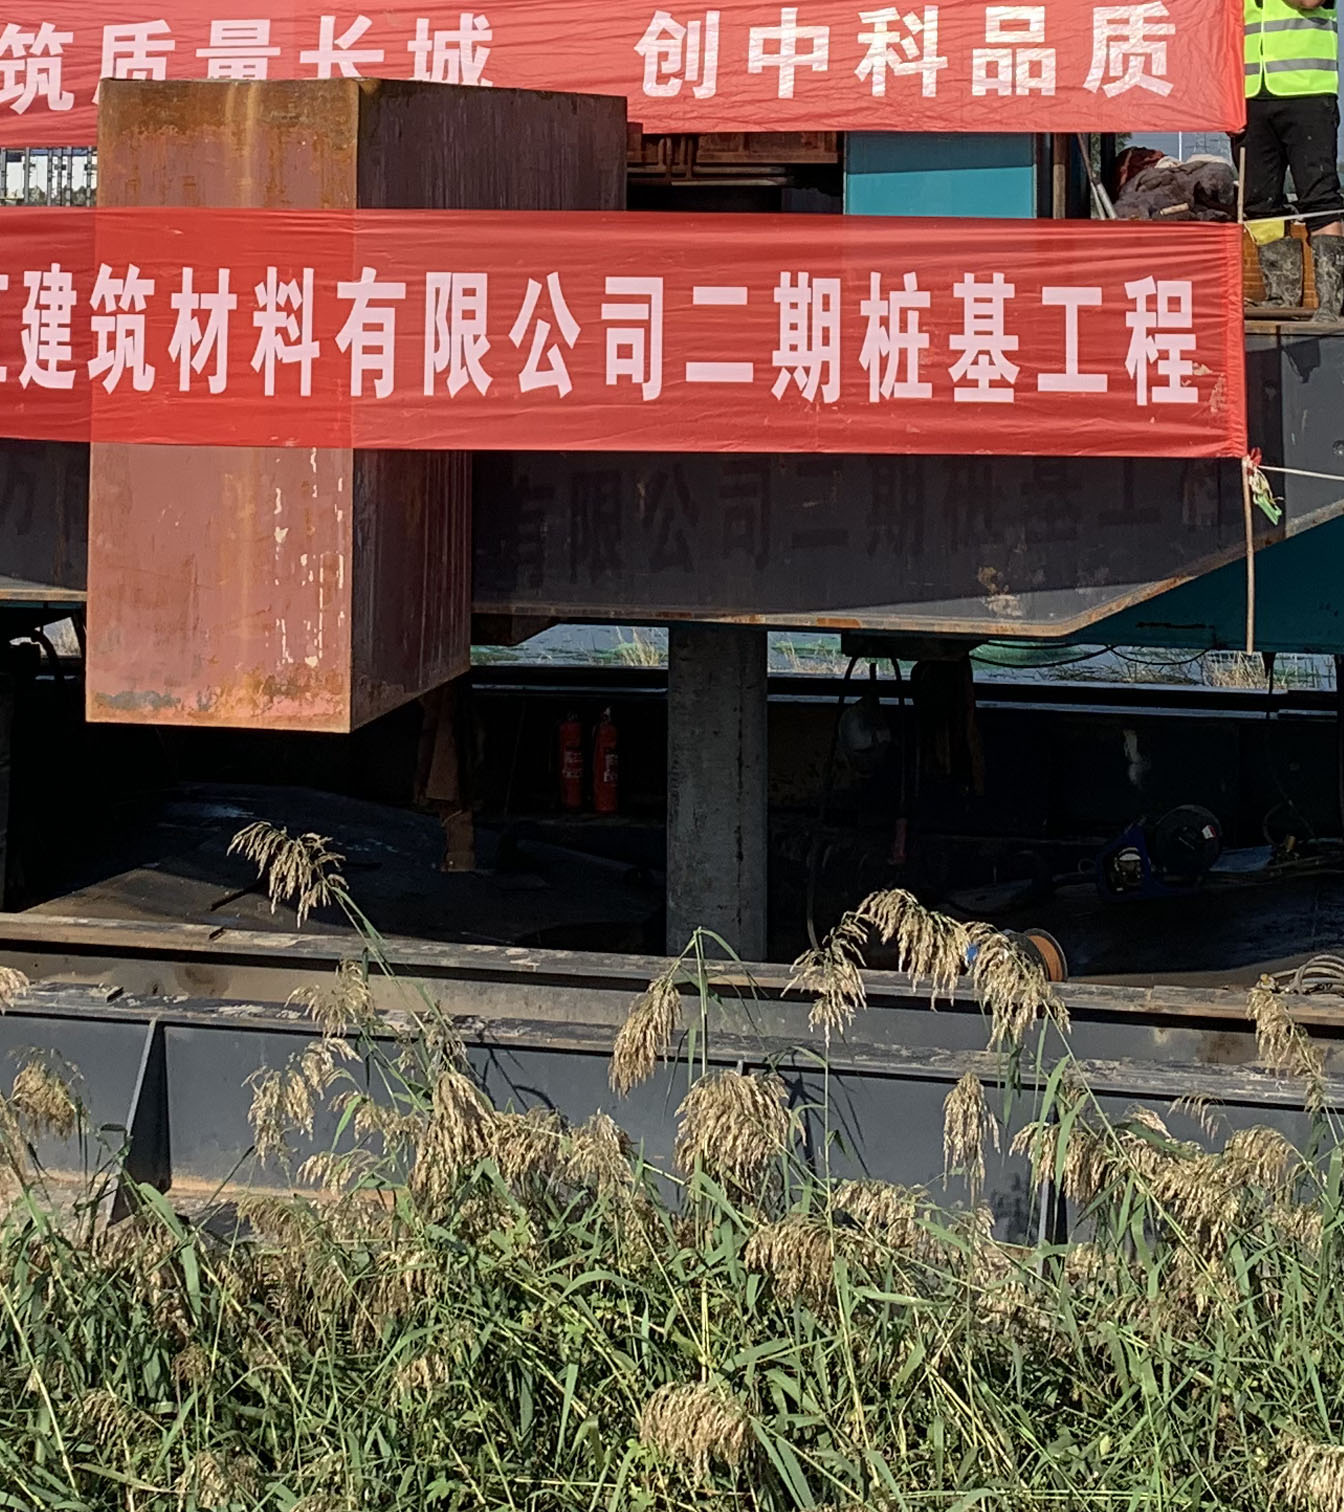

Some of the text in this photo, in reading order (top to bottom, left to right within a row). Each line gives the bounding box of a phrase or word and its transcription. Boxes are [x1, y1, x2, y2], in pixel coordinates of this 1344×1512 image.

[634, 0, 1176, 100] 创中科品质
